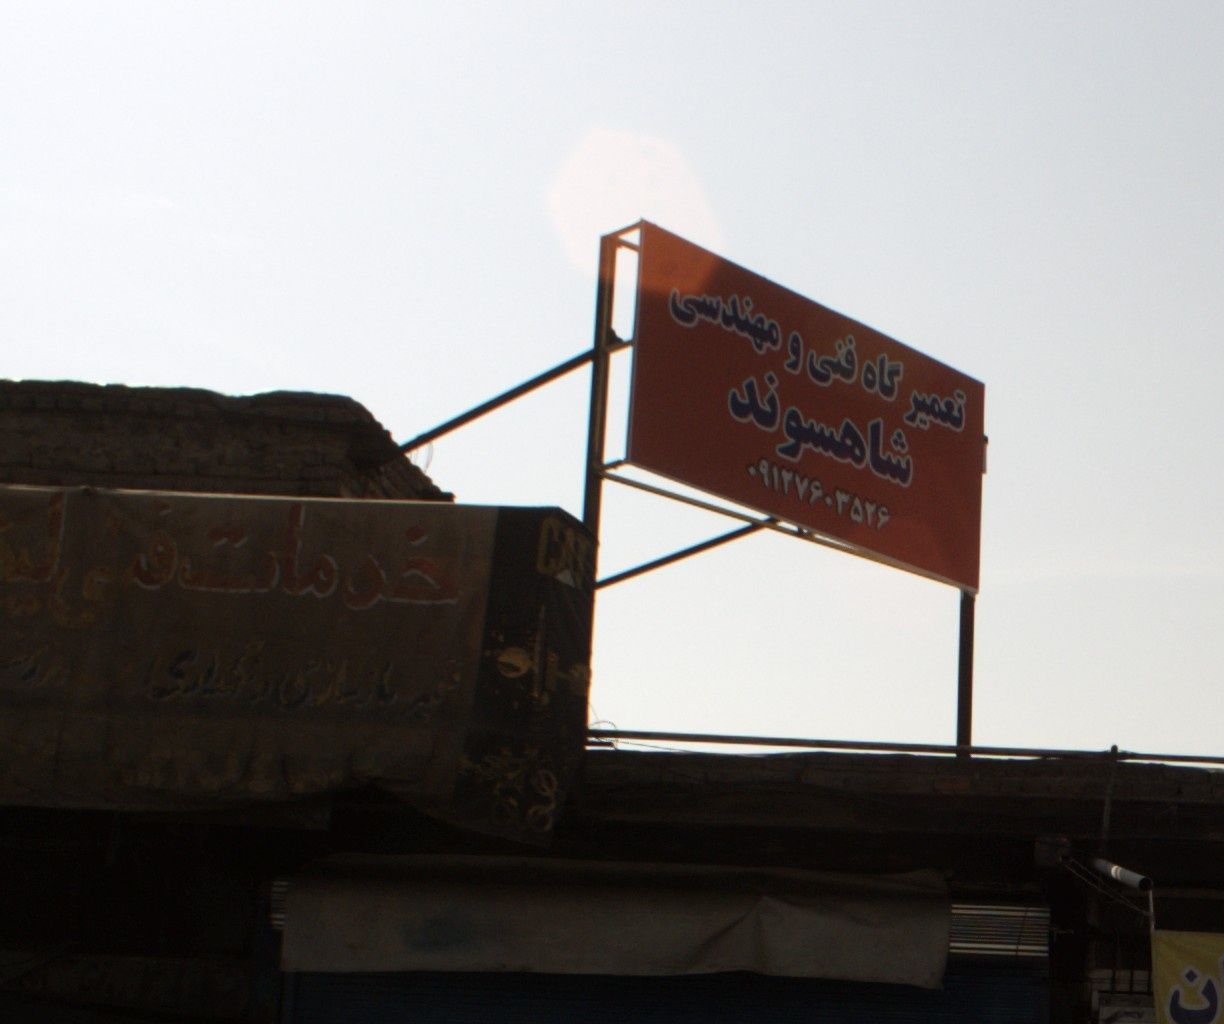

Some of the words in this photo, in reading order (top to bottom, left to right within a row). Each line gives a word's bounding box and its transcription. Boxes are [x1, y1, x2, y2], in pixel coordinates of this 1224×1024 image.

[670, 288, 782, 354] مهندسی
[784, 332, 804, 374] و
[807, 335, 858, 386] فنی
[862, 354, 904, 401] گاه
[728, 371, 914, 487] شاهسوند
[903, 389, 966, 431] تعمیر
